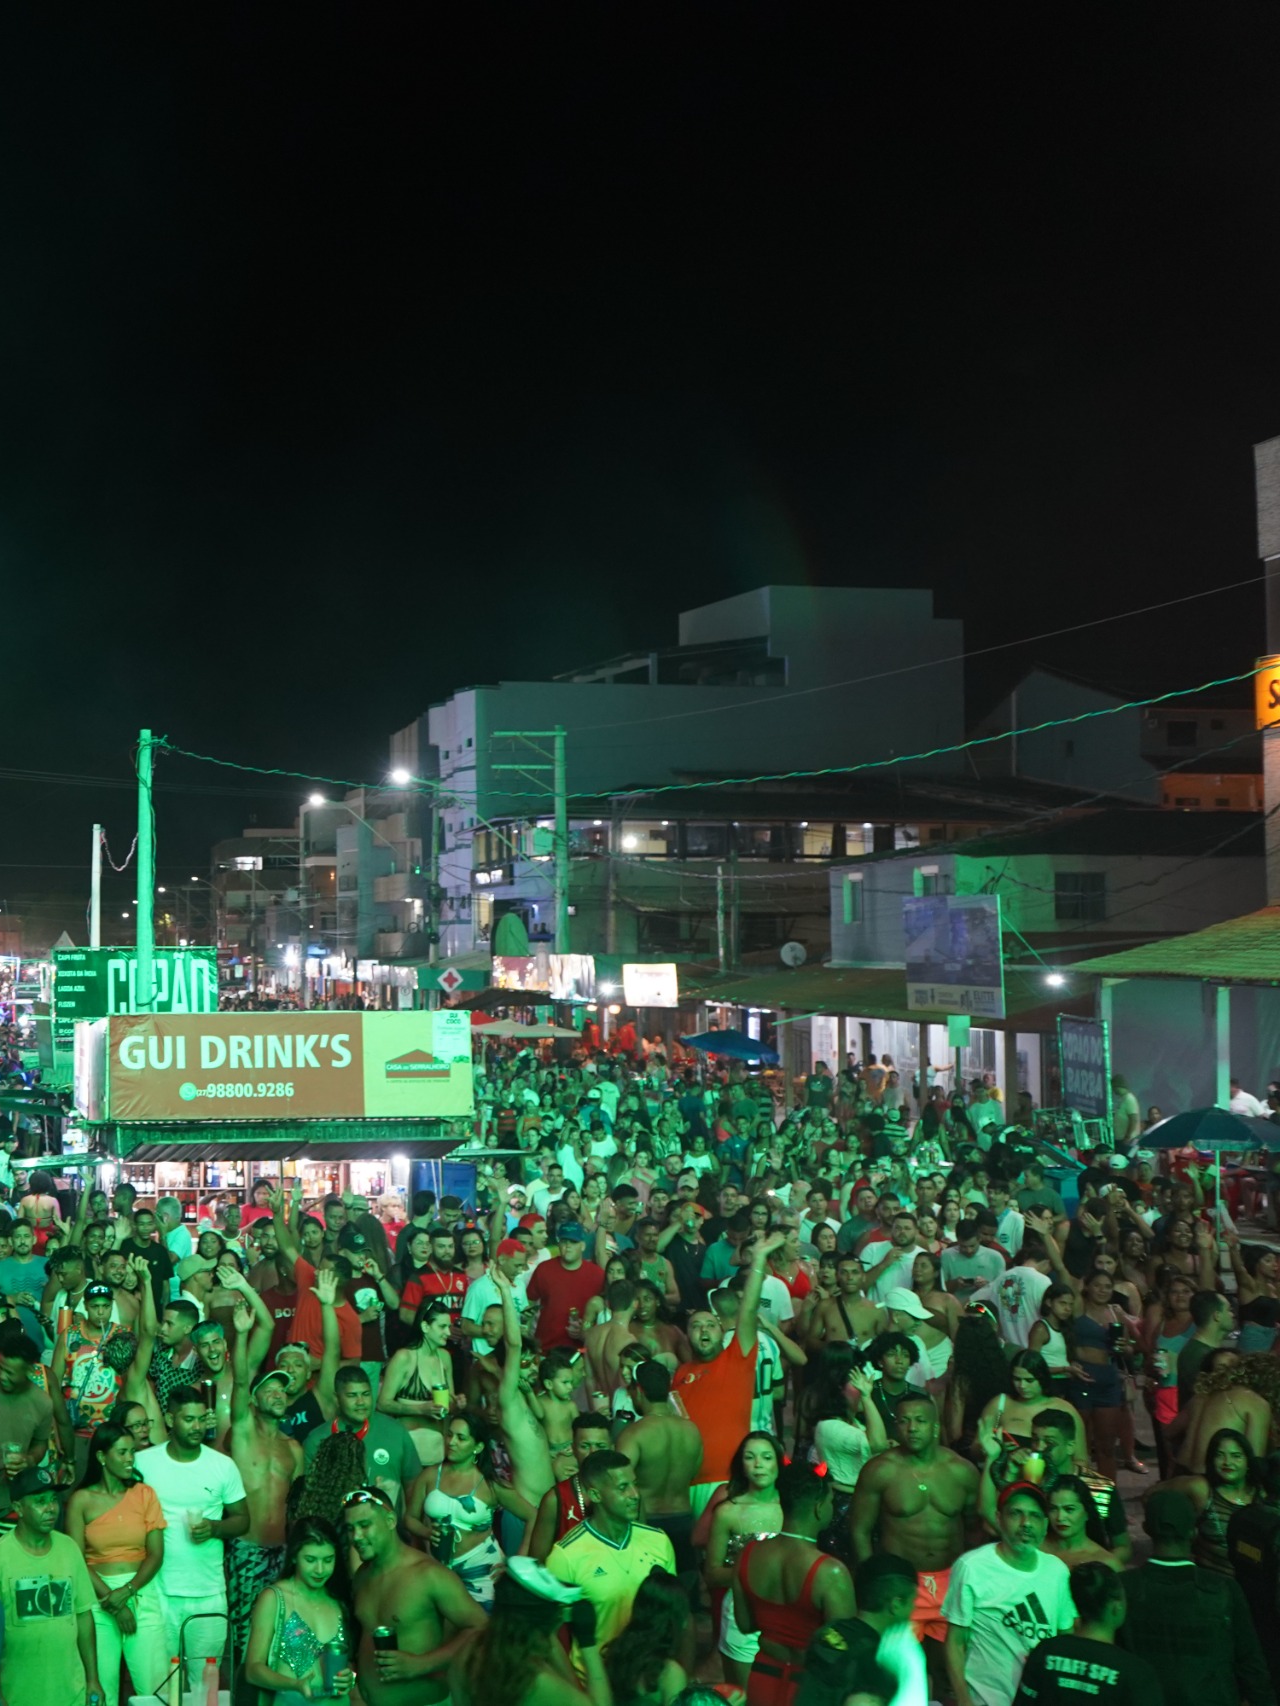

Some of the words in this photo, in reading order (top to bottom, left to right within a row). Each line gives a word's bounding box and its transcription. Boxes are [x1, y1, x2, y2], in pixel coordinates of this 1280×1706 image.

[118, 1035, 187, 1070] GUI
[200, 1033, 352, 1069] DRINK'S
[409, 1063, 450, 1071] SERRALHEIRO
[206, 1082, 295, 1098] 98800.9286
[1045, 1654, 1090, 1676] STAFF
